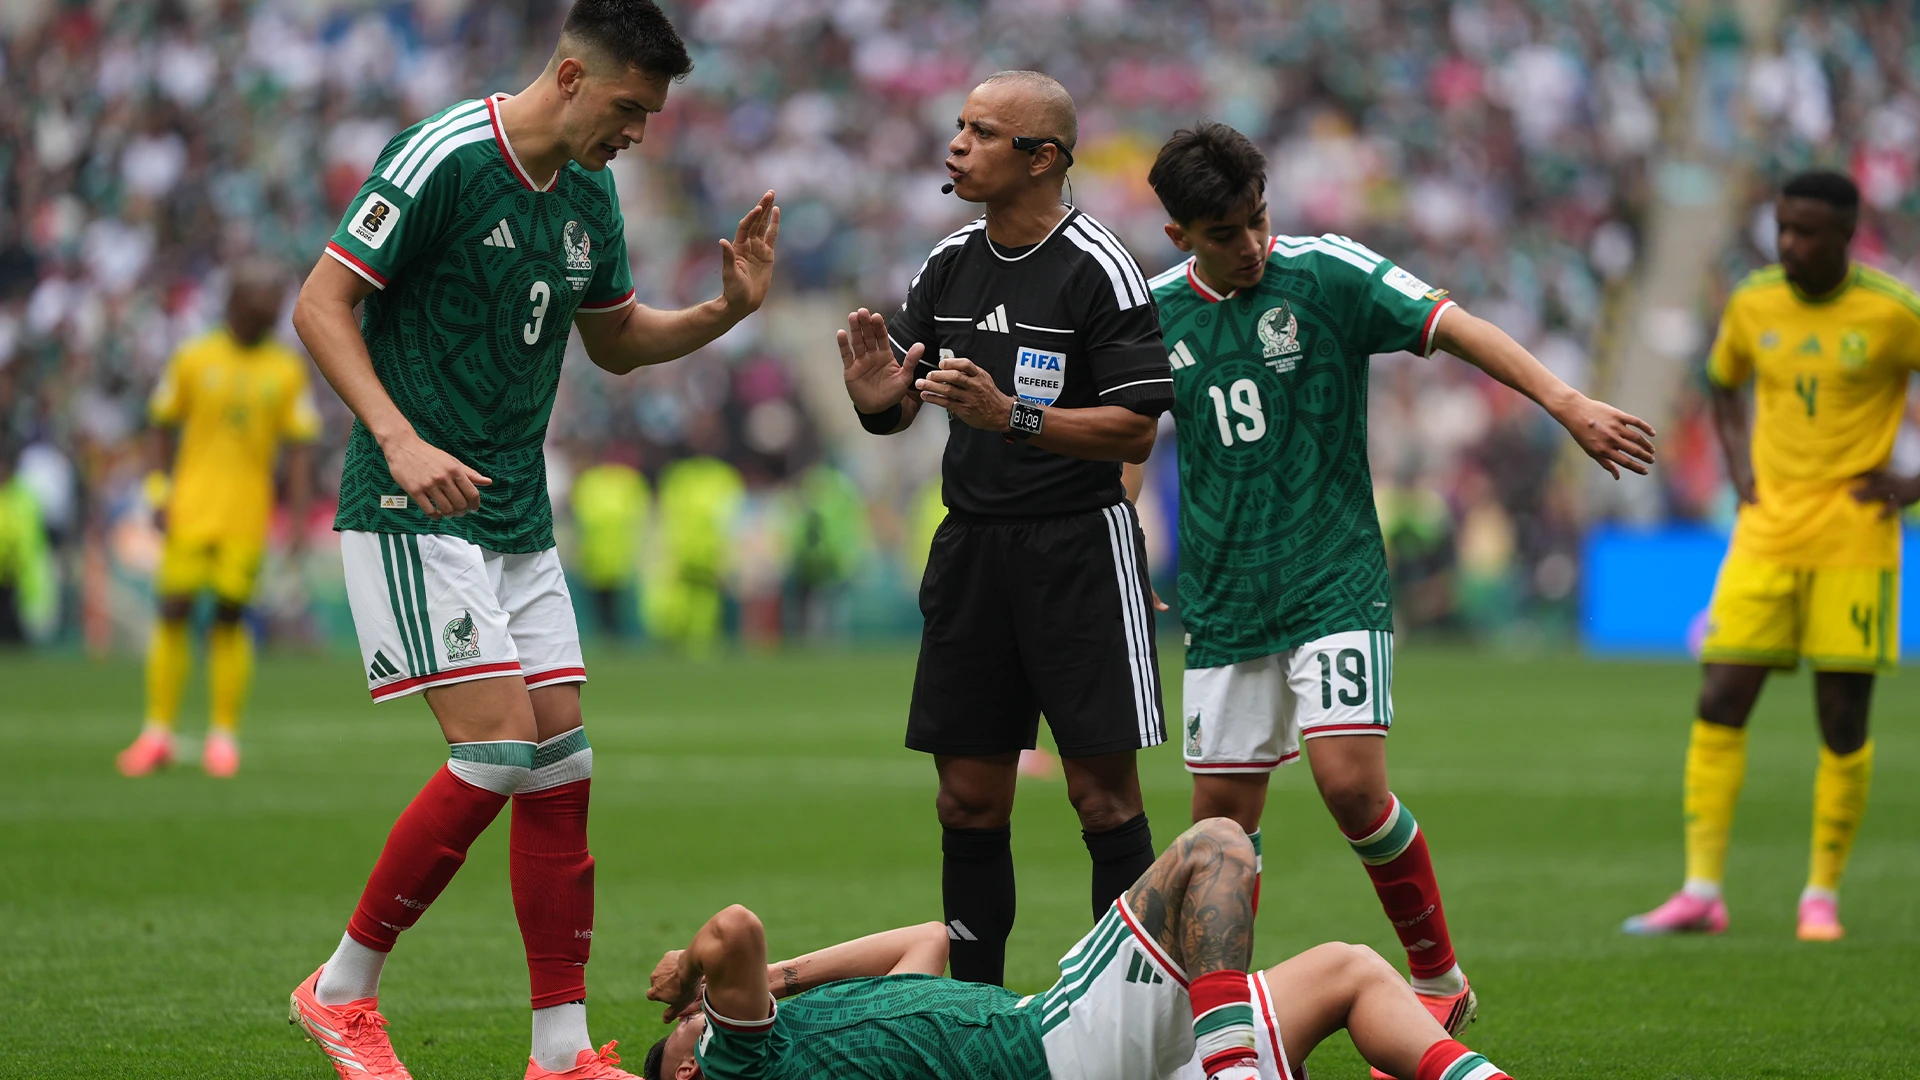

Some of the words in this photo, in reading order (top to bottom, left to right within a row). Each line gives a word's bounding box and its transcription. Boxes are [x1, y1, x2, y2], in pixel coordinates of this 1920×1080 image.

[356, 229, 373, 242] 2026
[523, 281, 551, 345] 3
[1018, 376, 1059, 389] REFEREE
[1020, 351, 1061, 371] FIFA
[1208, 378, 1267, 447] 19
[1795, 374, 1818, 417] 4
[1013, 410, 1040, 428] 81:08
[1850, 602, 1872, 648] 4
[1317, 648, 1367, 710] 19
